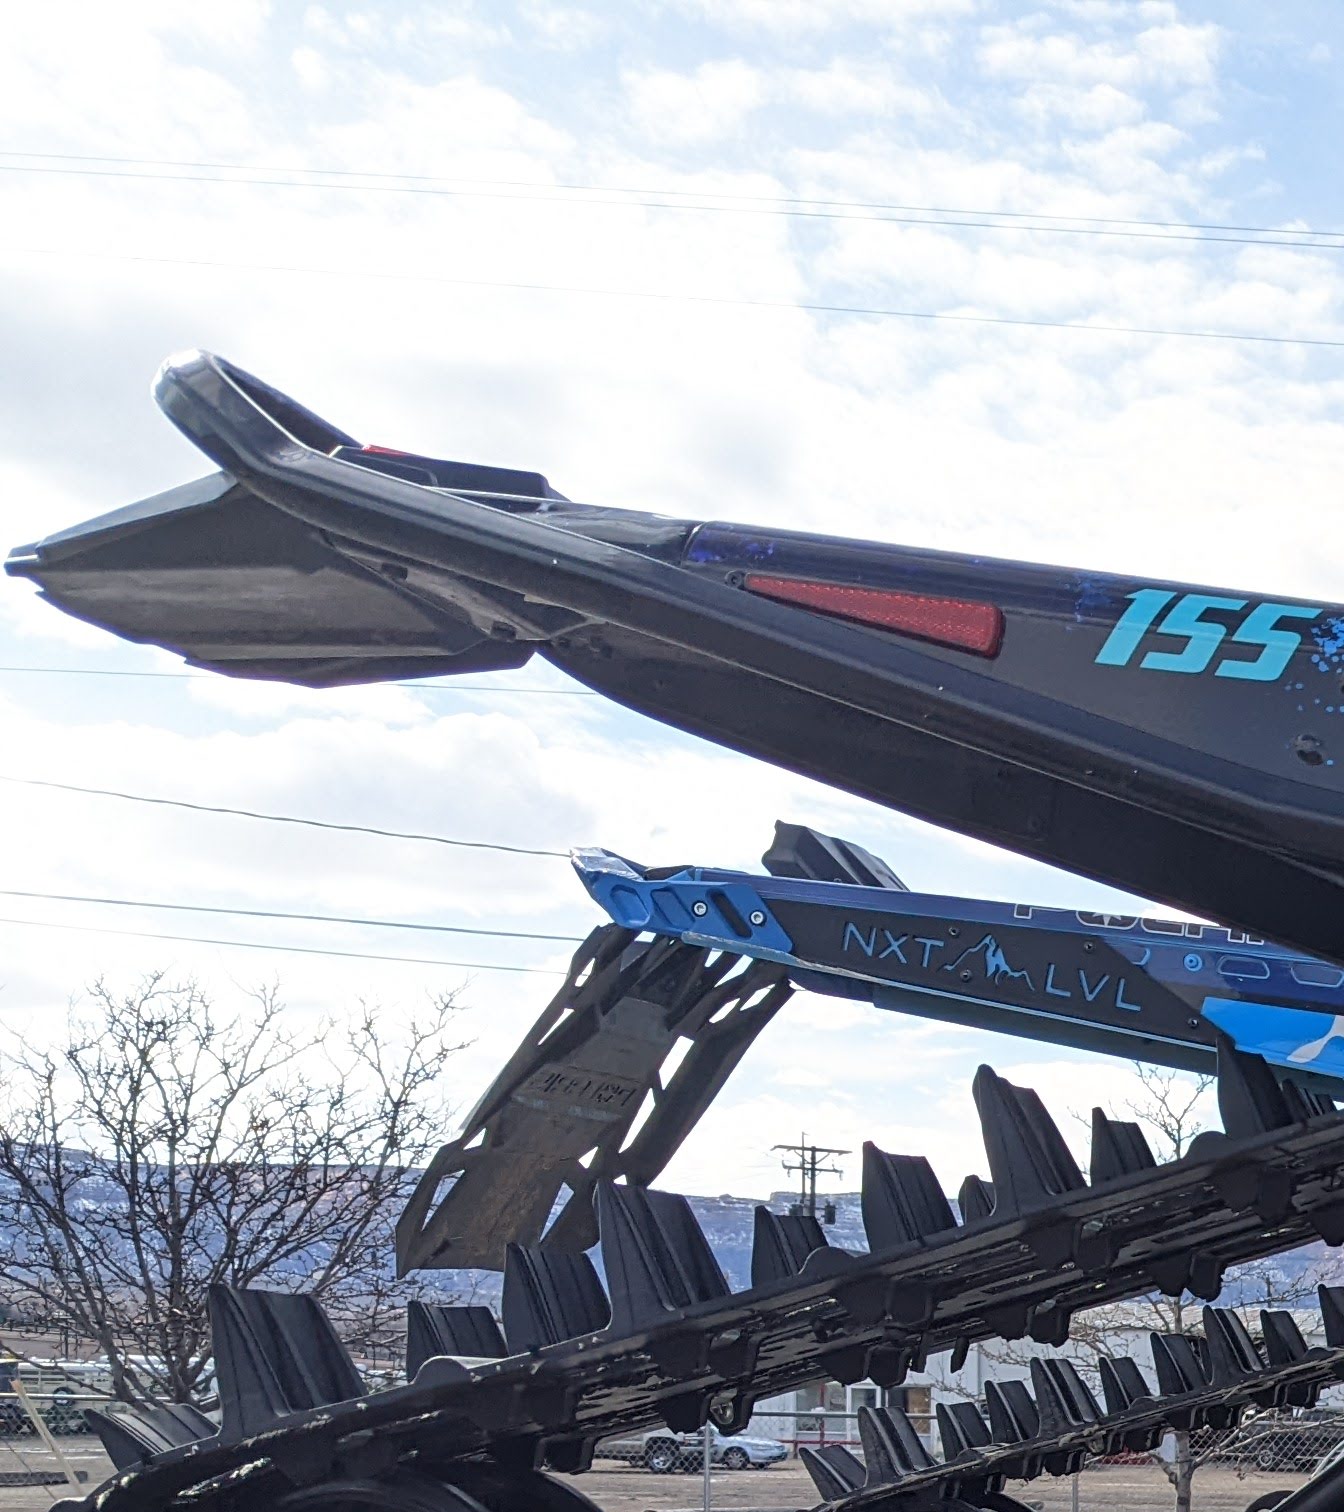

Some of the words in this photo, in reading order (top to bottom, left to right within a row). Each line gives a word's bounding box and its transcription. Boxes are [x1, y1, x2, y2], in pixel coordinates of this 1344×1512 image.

[1094, 588, 1322, 682] 155
[842, 922, 945, 969] NXT
[1045, 963, 1142, 1012] LVL
